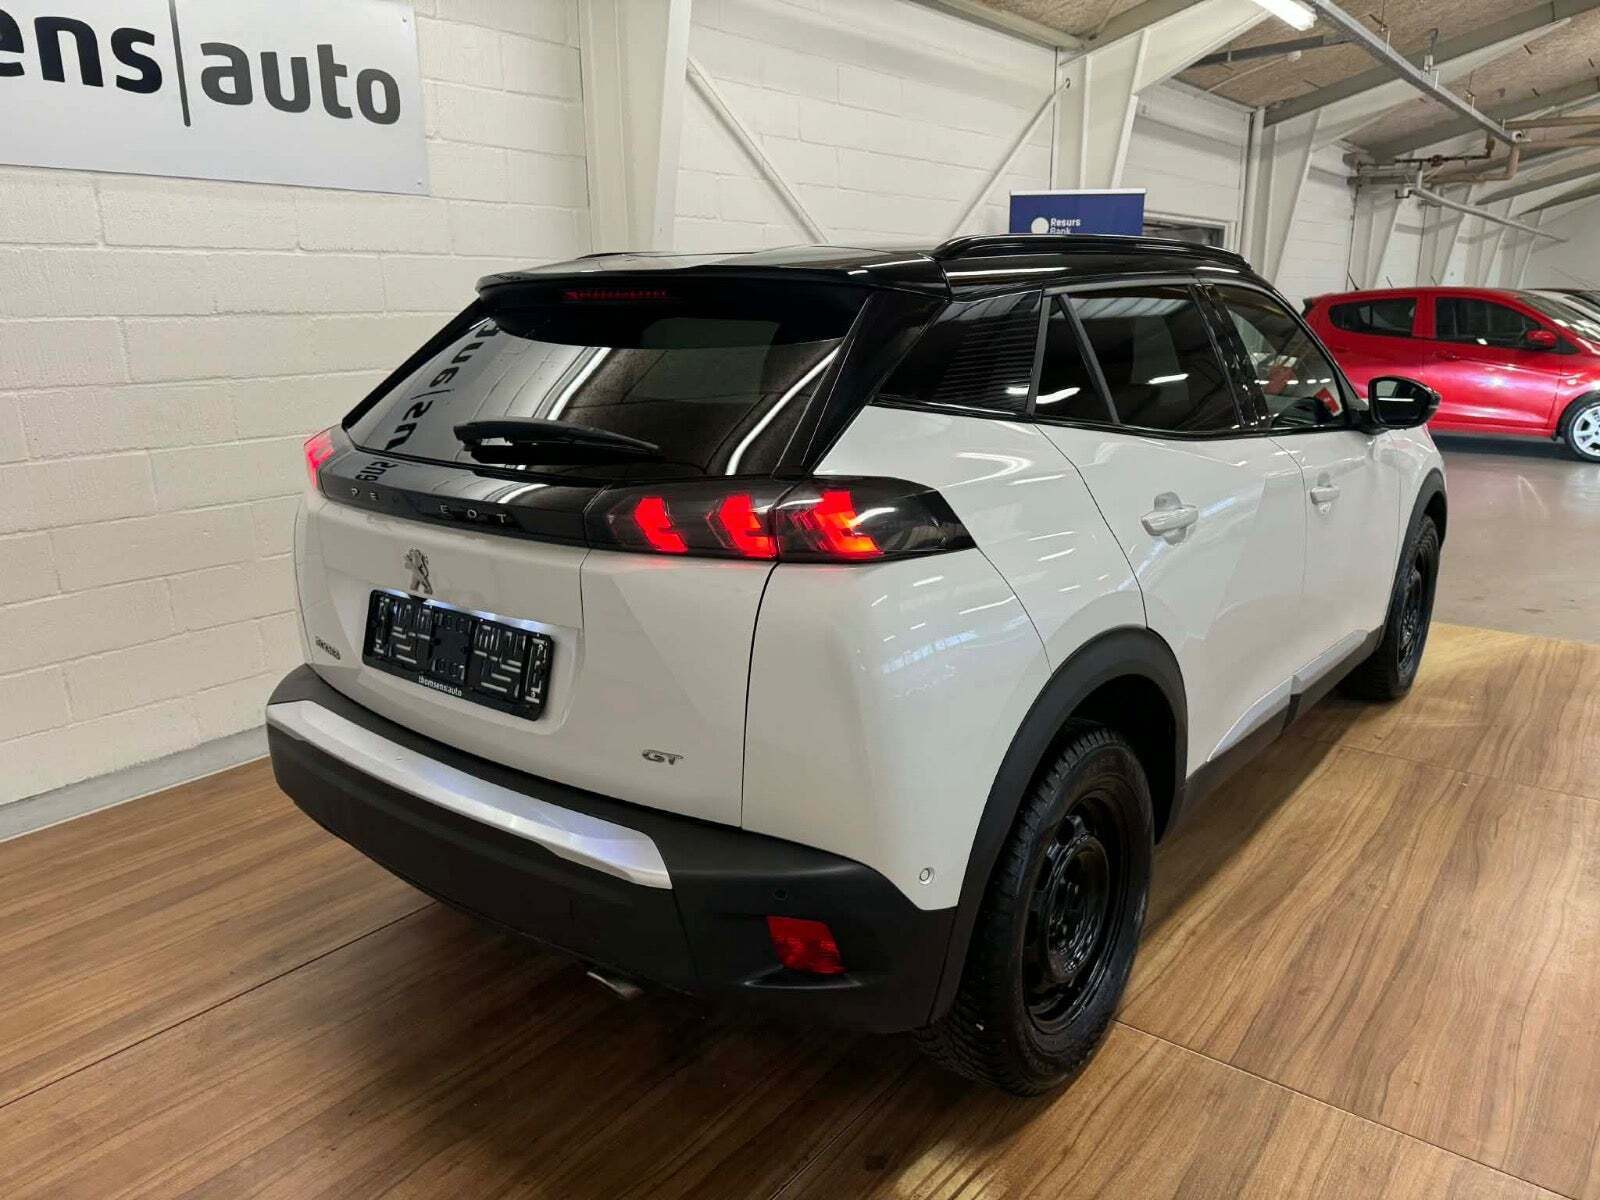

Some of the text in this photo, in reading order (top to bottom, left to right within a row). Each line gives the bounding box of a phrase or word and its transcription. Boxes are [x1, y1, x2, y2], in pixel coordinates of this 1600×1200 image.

[200, 42, 401, 125] auto
[1050, 217, 1081, 227] Resurs
[641, 749, 684, 766] GT
